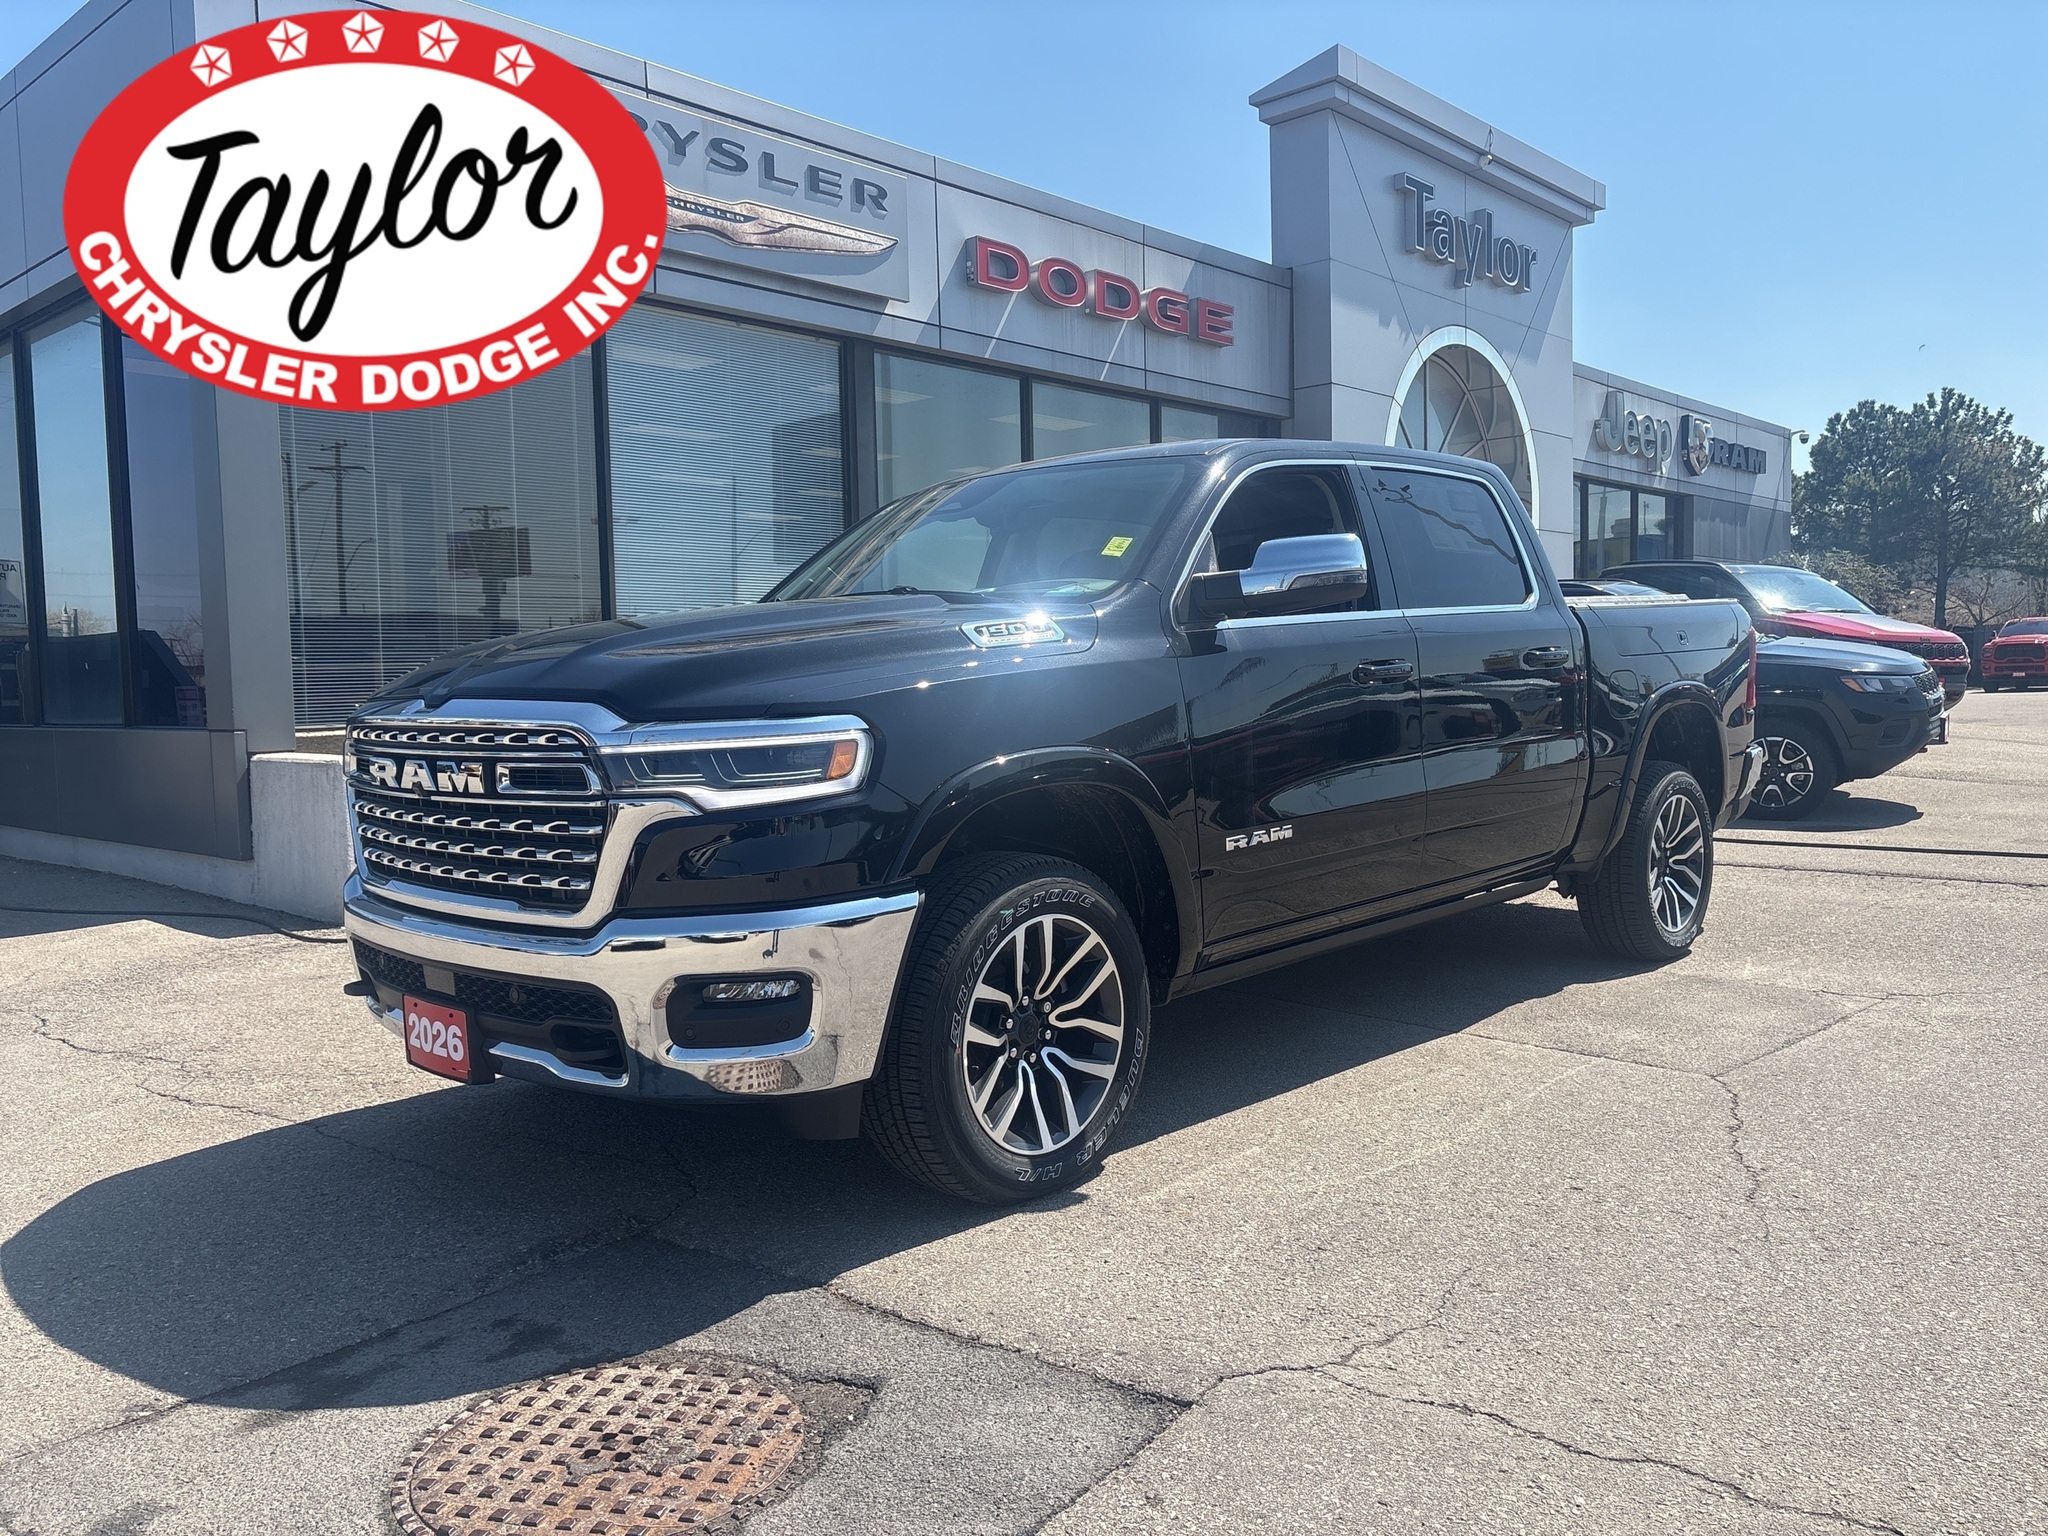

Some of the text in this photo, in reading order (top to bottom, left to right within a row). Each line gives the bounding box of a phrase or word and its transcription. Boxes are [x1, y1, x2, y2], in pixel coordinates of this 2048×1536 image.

[1395, 172, 1538, 294] Taylor
[966, 235, 1235, 346] DODGE
[1594, 389, 1673, 475] Jeep
[1709, 437, 1767, 474] RAM
[369, 757, 484, 794] RAM
[1225, 824, 1293, 852] RAM
[951, 889, 1096, 1045] BRIDGESTONE
[408, 1012, 464, 1062] 2026
[1076, 1027, 1144, 1166] DUELER
[1015, 1162, 1062, 1182] H/L
